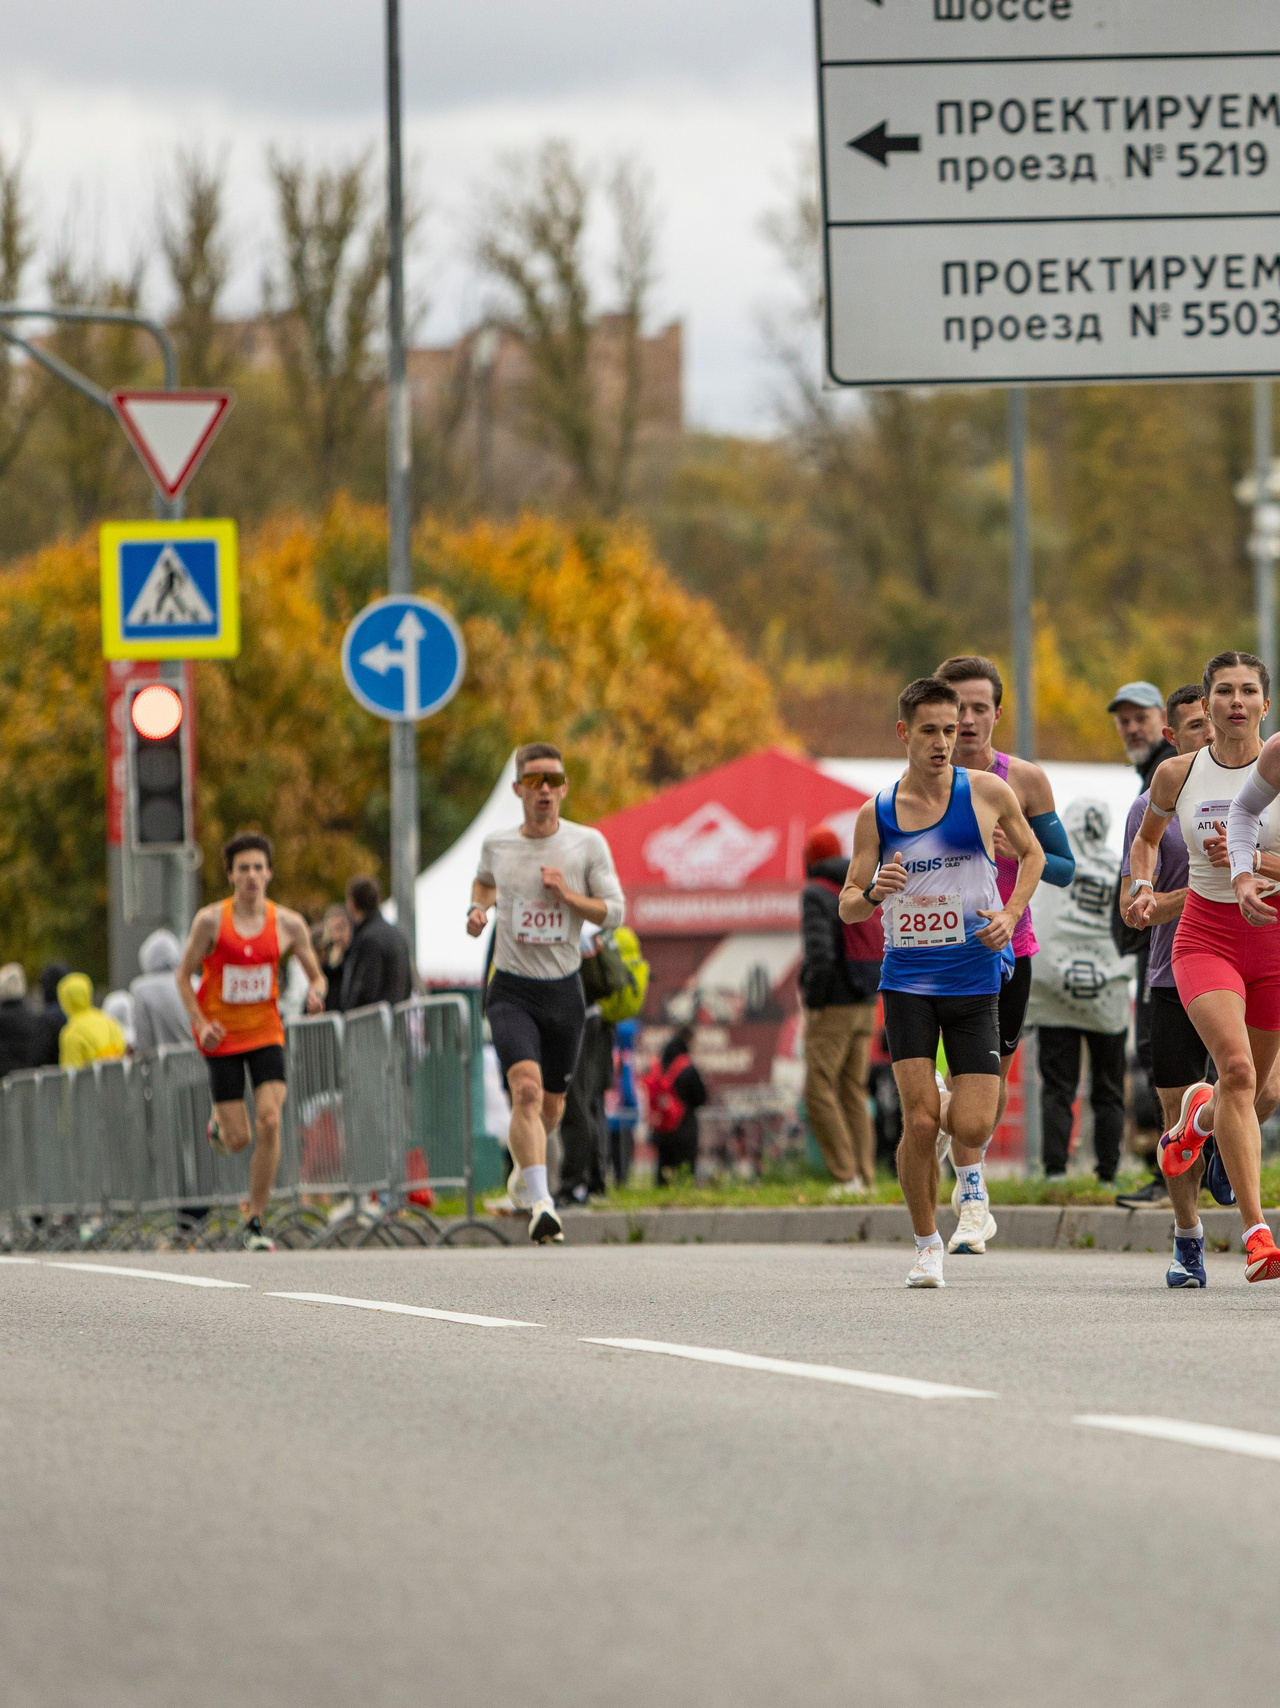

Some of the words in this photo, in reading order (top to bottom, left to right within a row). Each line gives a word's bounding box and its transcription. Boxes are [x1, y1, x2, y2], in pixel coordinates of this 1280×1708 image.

[938, 152, 1097, 192] проезд
[1176, 140, 1269, 179] 5219
[944, 313, 1103, 351] проезд
[945, 854, 971, 863] running
[521, 910, 563, 928] 2011
[899, 911, 959, 932] 2820
